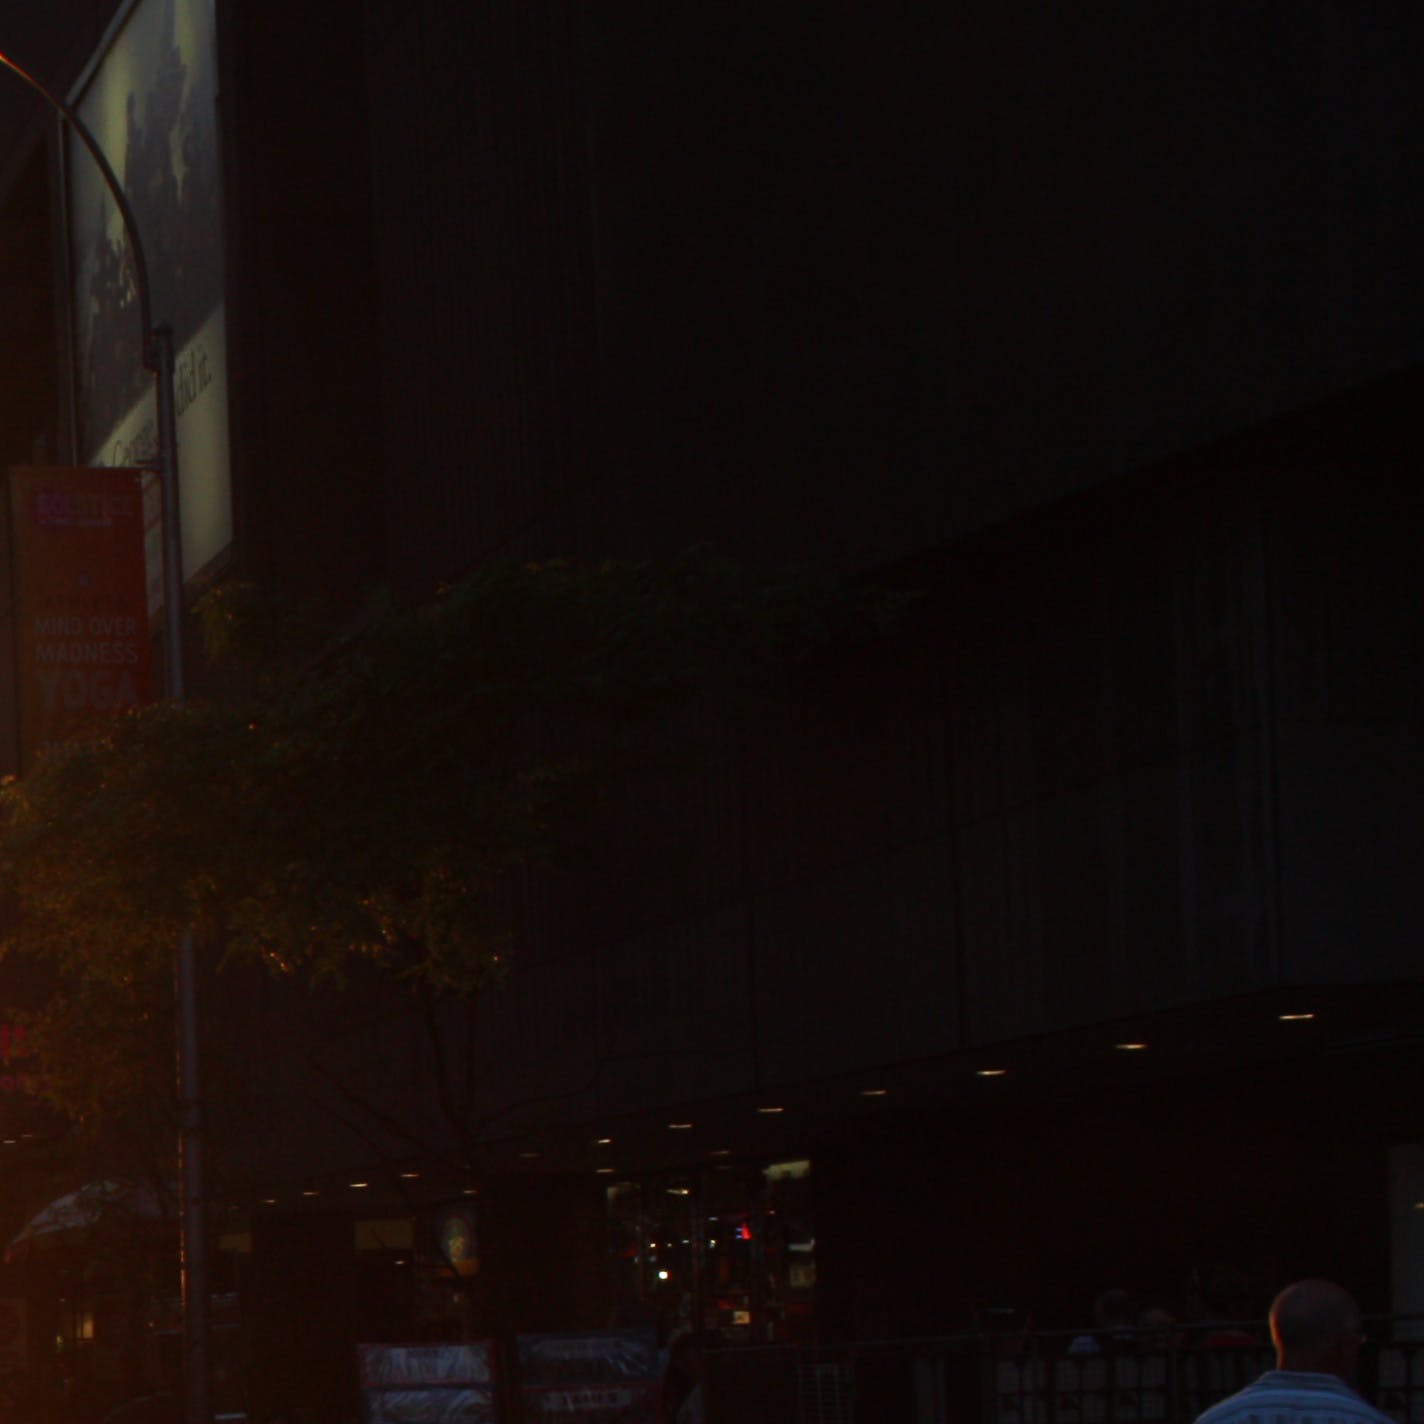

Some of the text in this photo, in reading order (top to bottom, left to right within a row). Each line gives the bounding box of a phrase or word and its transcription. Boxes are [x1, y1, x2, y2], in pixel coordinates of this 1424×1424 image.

[34, 614, 137, 636] MIND OVER
[34, 641, 139, 664] MADNESS
[37, 668, 140, 709] YOGA
